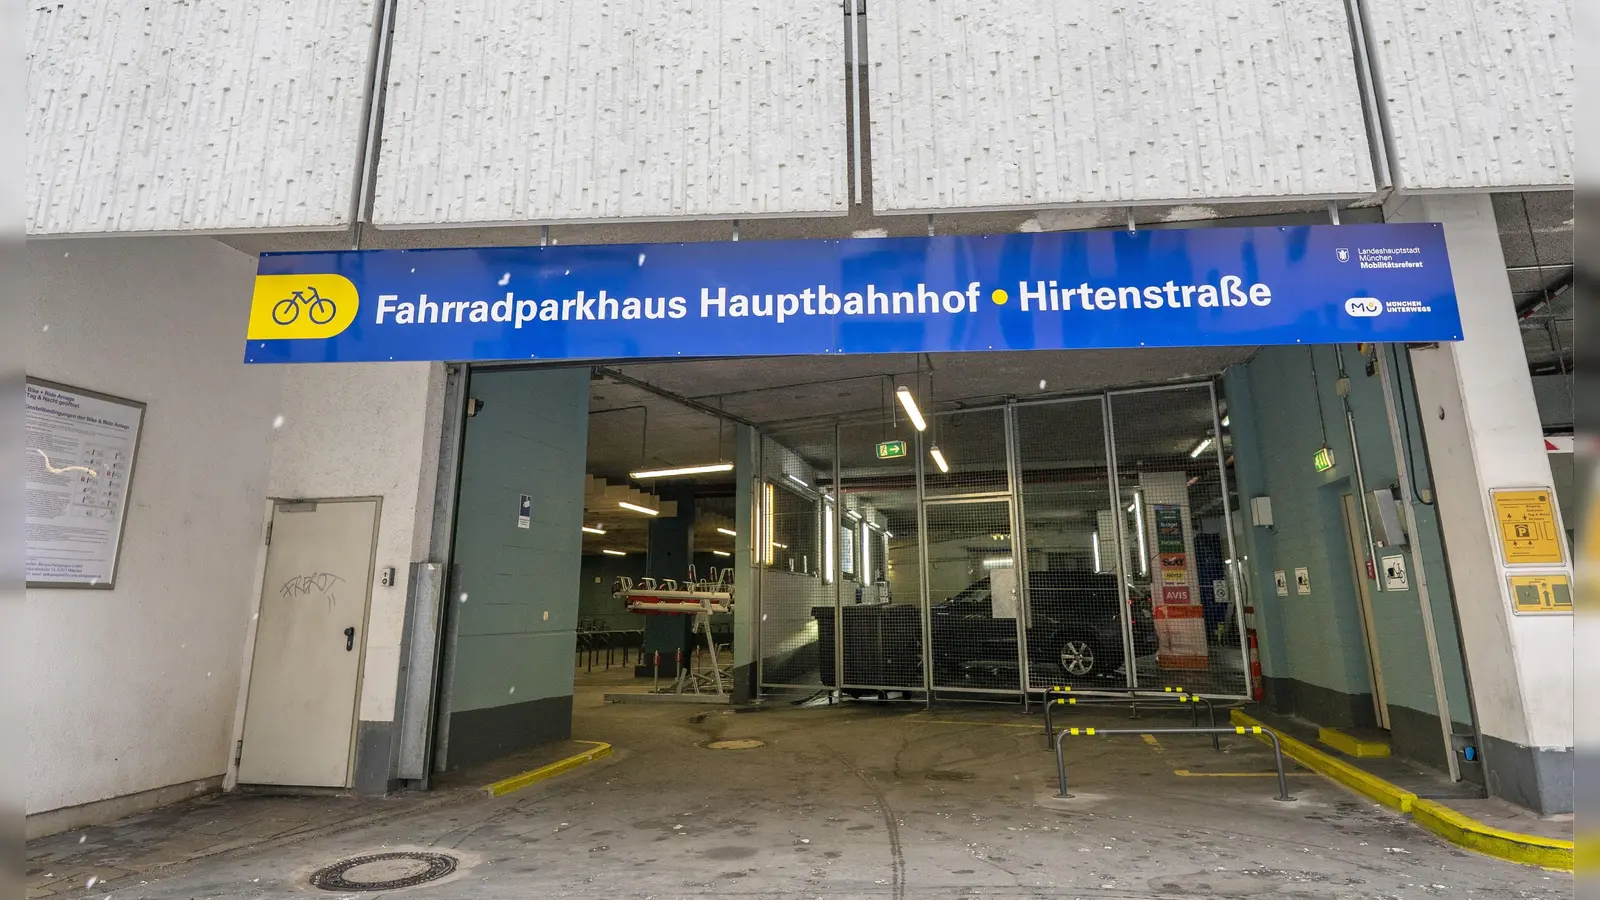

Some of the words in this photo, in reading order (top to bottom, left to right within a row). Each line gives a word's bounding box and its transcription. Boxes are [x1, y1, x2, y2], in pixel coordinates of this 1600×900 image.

[1358, 247, 1421, 255] Landeshauptstadt
[1359, 254, 1393, 262] München
[1360, 260, 1424, 269] Mobilitätsreferat
[375, 290, 687, 329] Fahrradparkhaus
[700, 281, 981, 323] Hauptbahnhof
[1018, 275, 1272, 311] Hirtenstraße
[27, 386, 39, 394] Bike
[57, 394, 75, 402] Anlage
[26, 392, 37, 401] Tag
[43, 396, 58, 404] Nacht
[59, 400, 80, 408] geöffnet
[1166, 591, 1187, 600] AVIS
